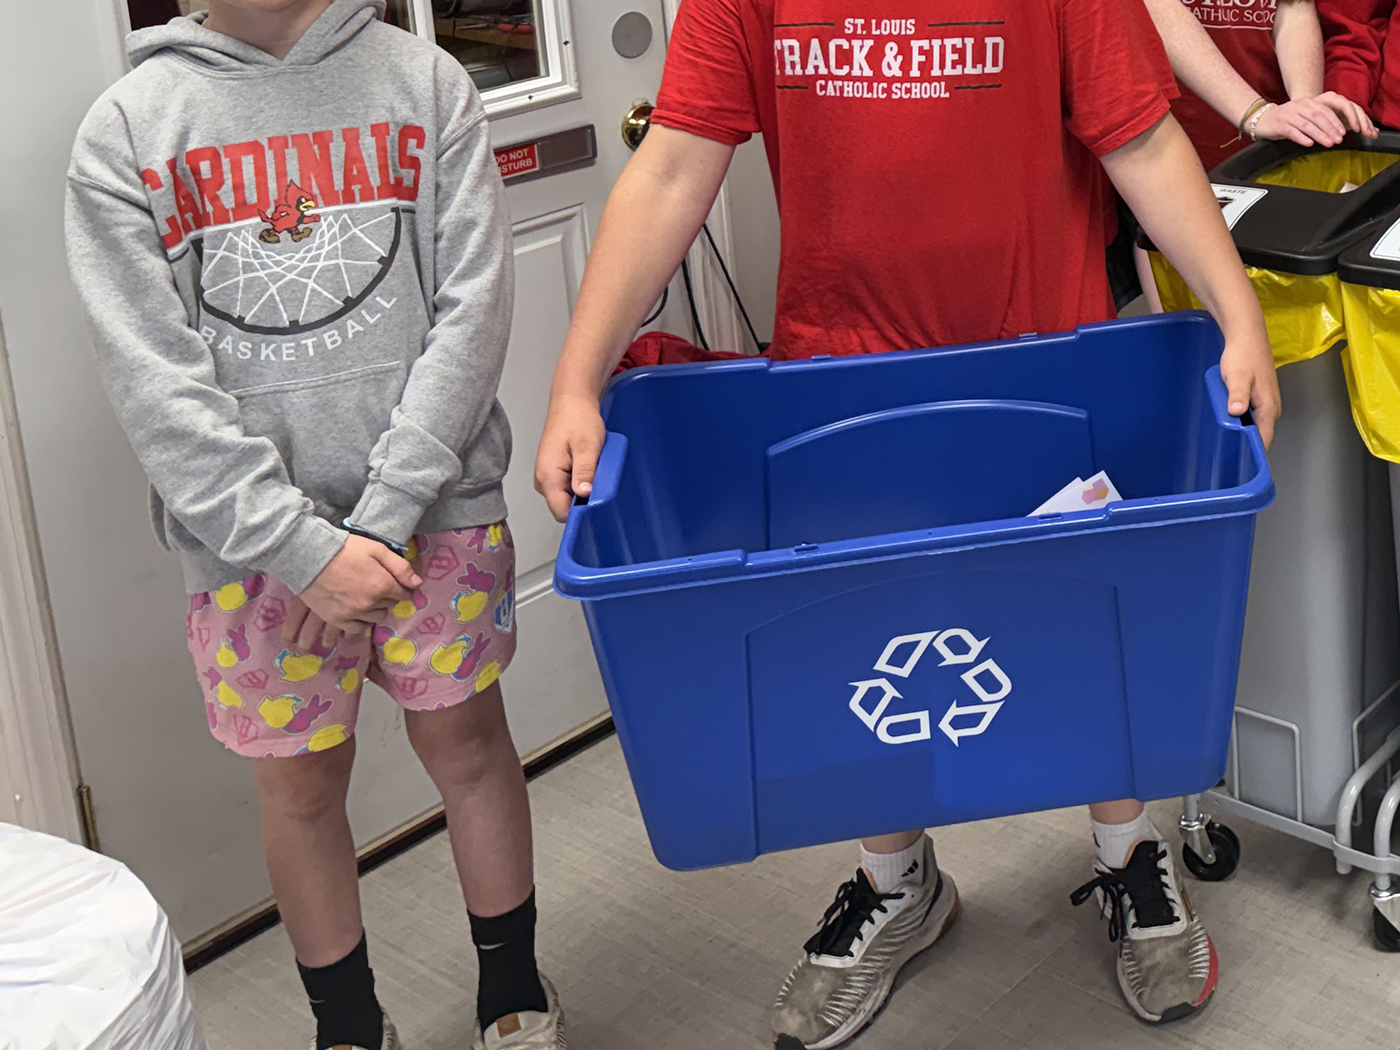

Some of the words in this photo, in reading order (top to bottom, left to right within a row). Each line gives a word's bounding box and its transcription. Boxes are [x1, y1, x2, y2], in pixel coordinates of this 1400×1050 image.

[844, 18, 867, 35] ST.
[871, 18, 915, 35] LOUIS
[881, 41, 903, 77] &
[909, 36, 1005, 77] FIELD
[816, 80, 888, 99] CATHOLIC
[891, 81, 950, 99] SCHOOL
[509, 148, 529, 161] NOT
[501, 158, 533, 173] STURB
[141, 121, 426, 250] CARDINALS
[1219, 187, 1248, 195] WASTE
[199, 294, 398, 362] BASKETBALL
